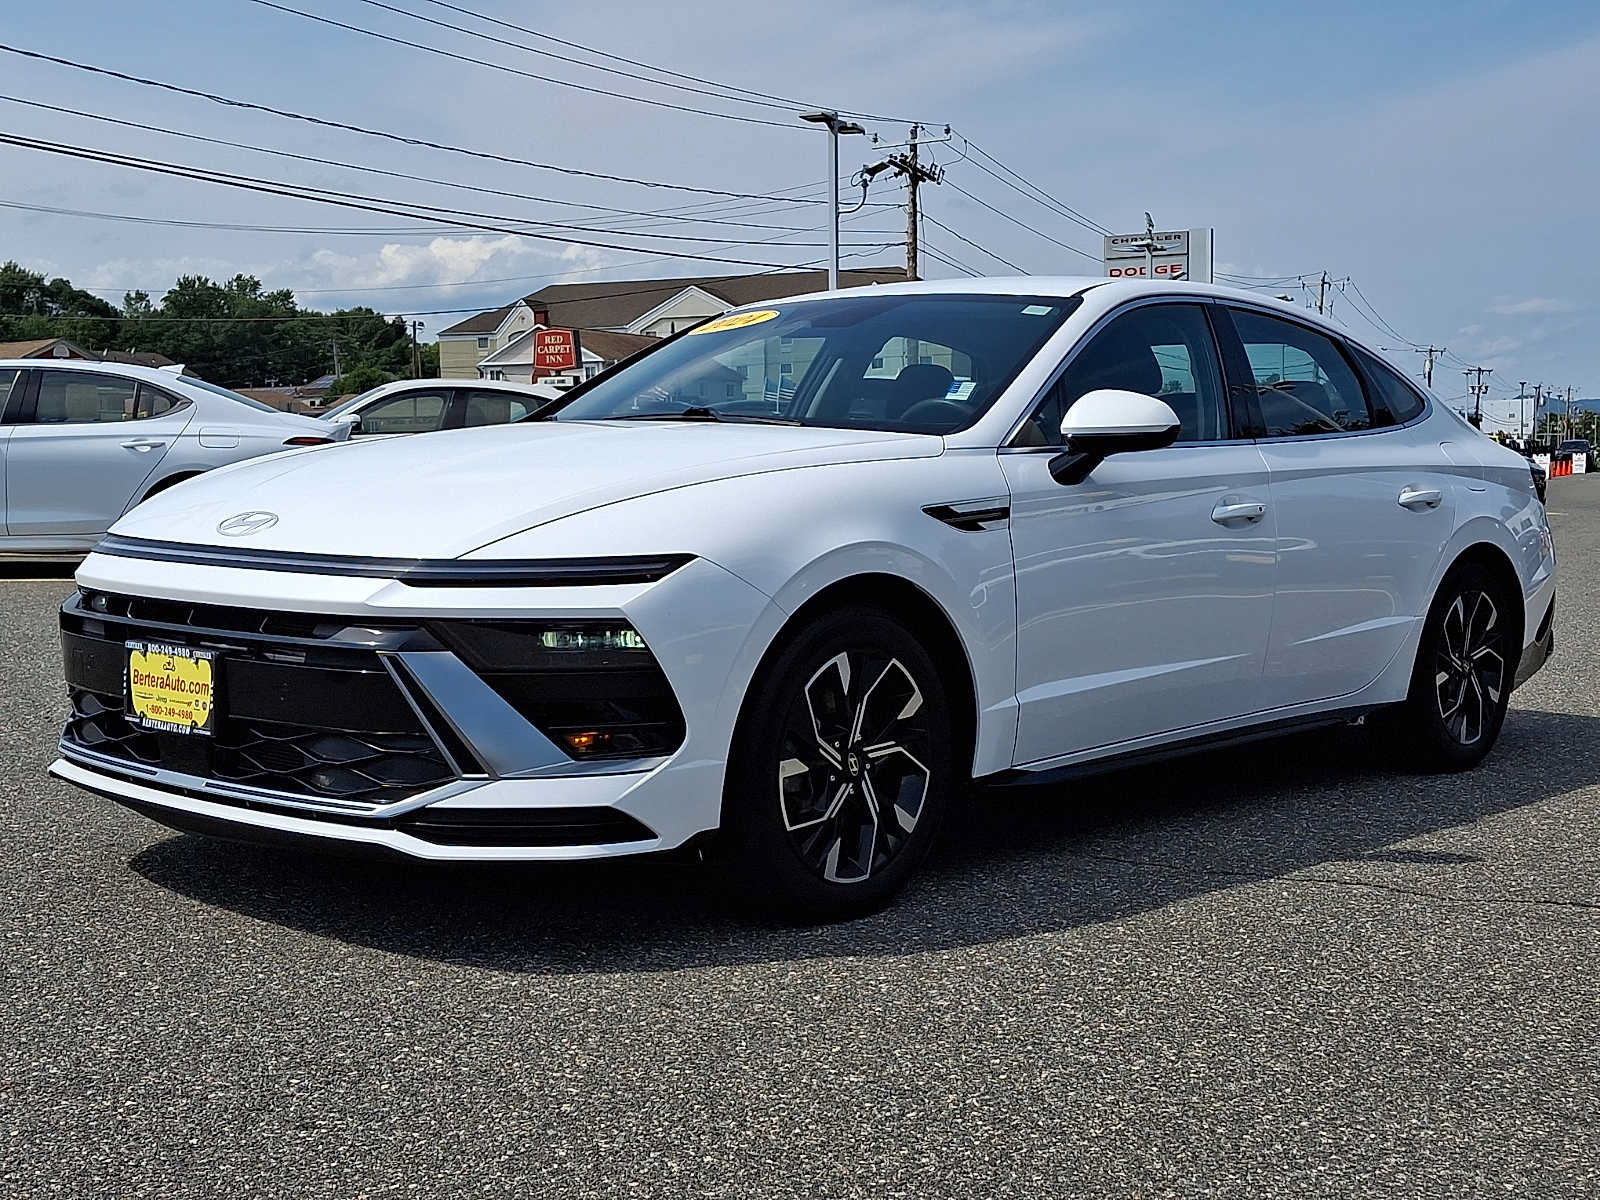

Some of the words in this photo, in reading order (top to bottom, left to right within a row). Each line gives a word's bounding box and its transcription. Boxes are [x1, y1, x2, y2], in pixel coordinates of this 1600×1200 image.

[1111, 235, 1182, 245] CHRYLER
[544, 335, 563, 344] RED
[537, 344, 571, 354] CARPET
[545, 354, 563, 364] INN
[133, 668, 210, 696] BerteraAuto.com
[145, 703, 192, 720] 1-800-249-4980
